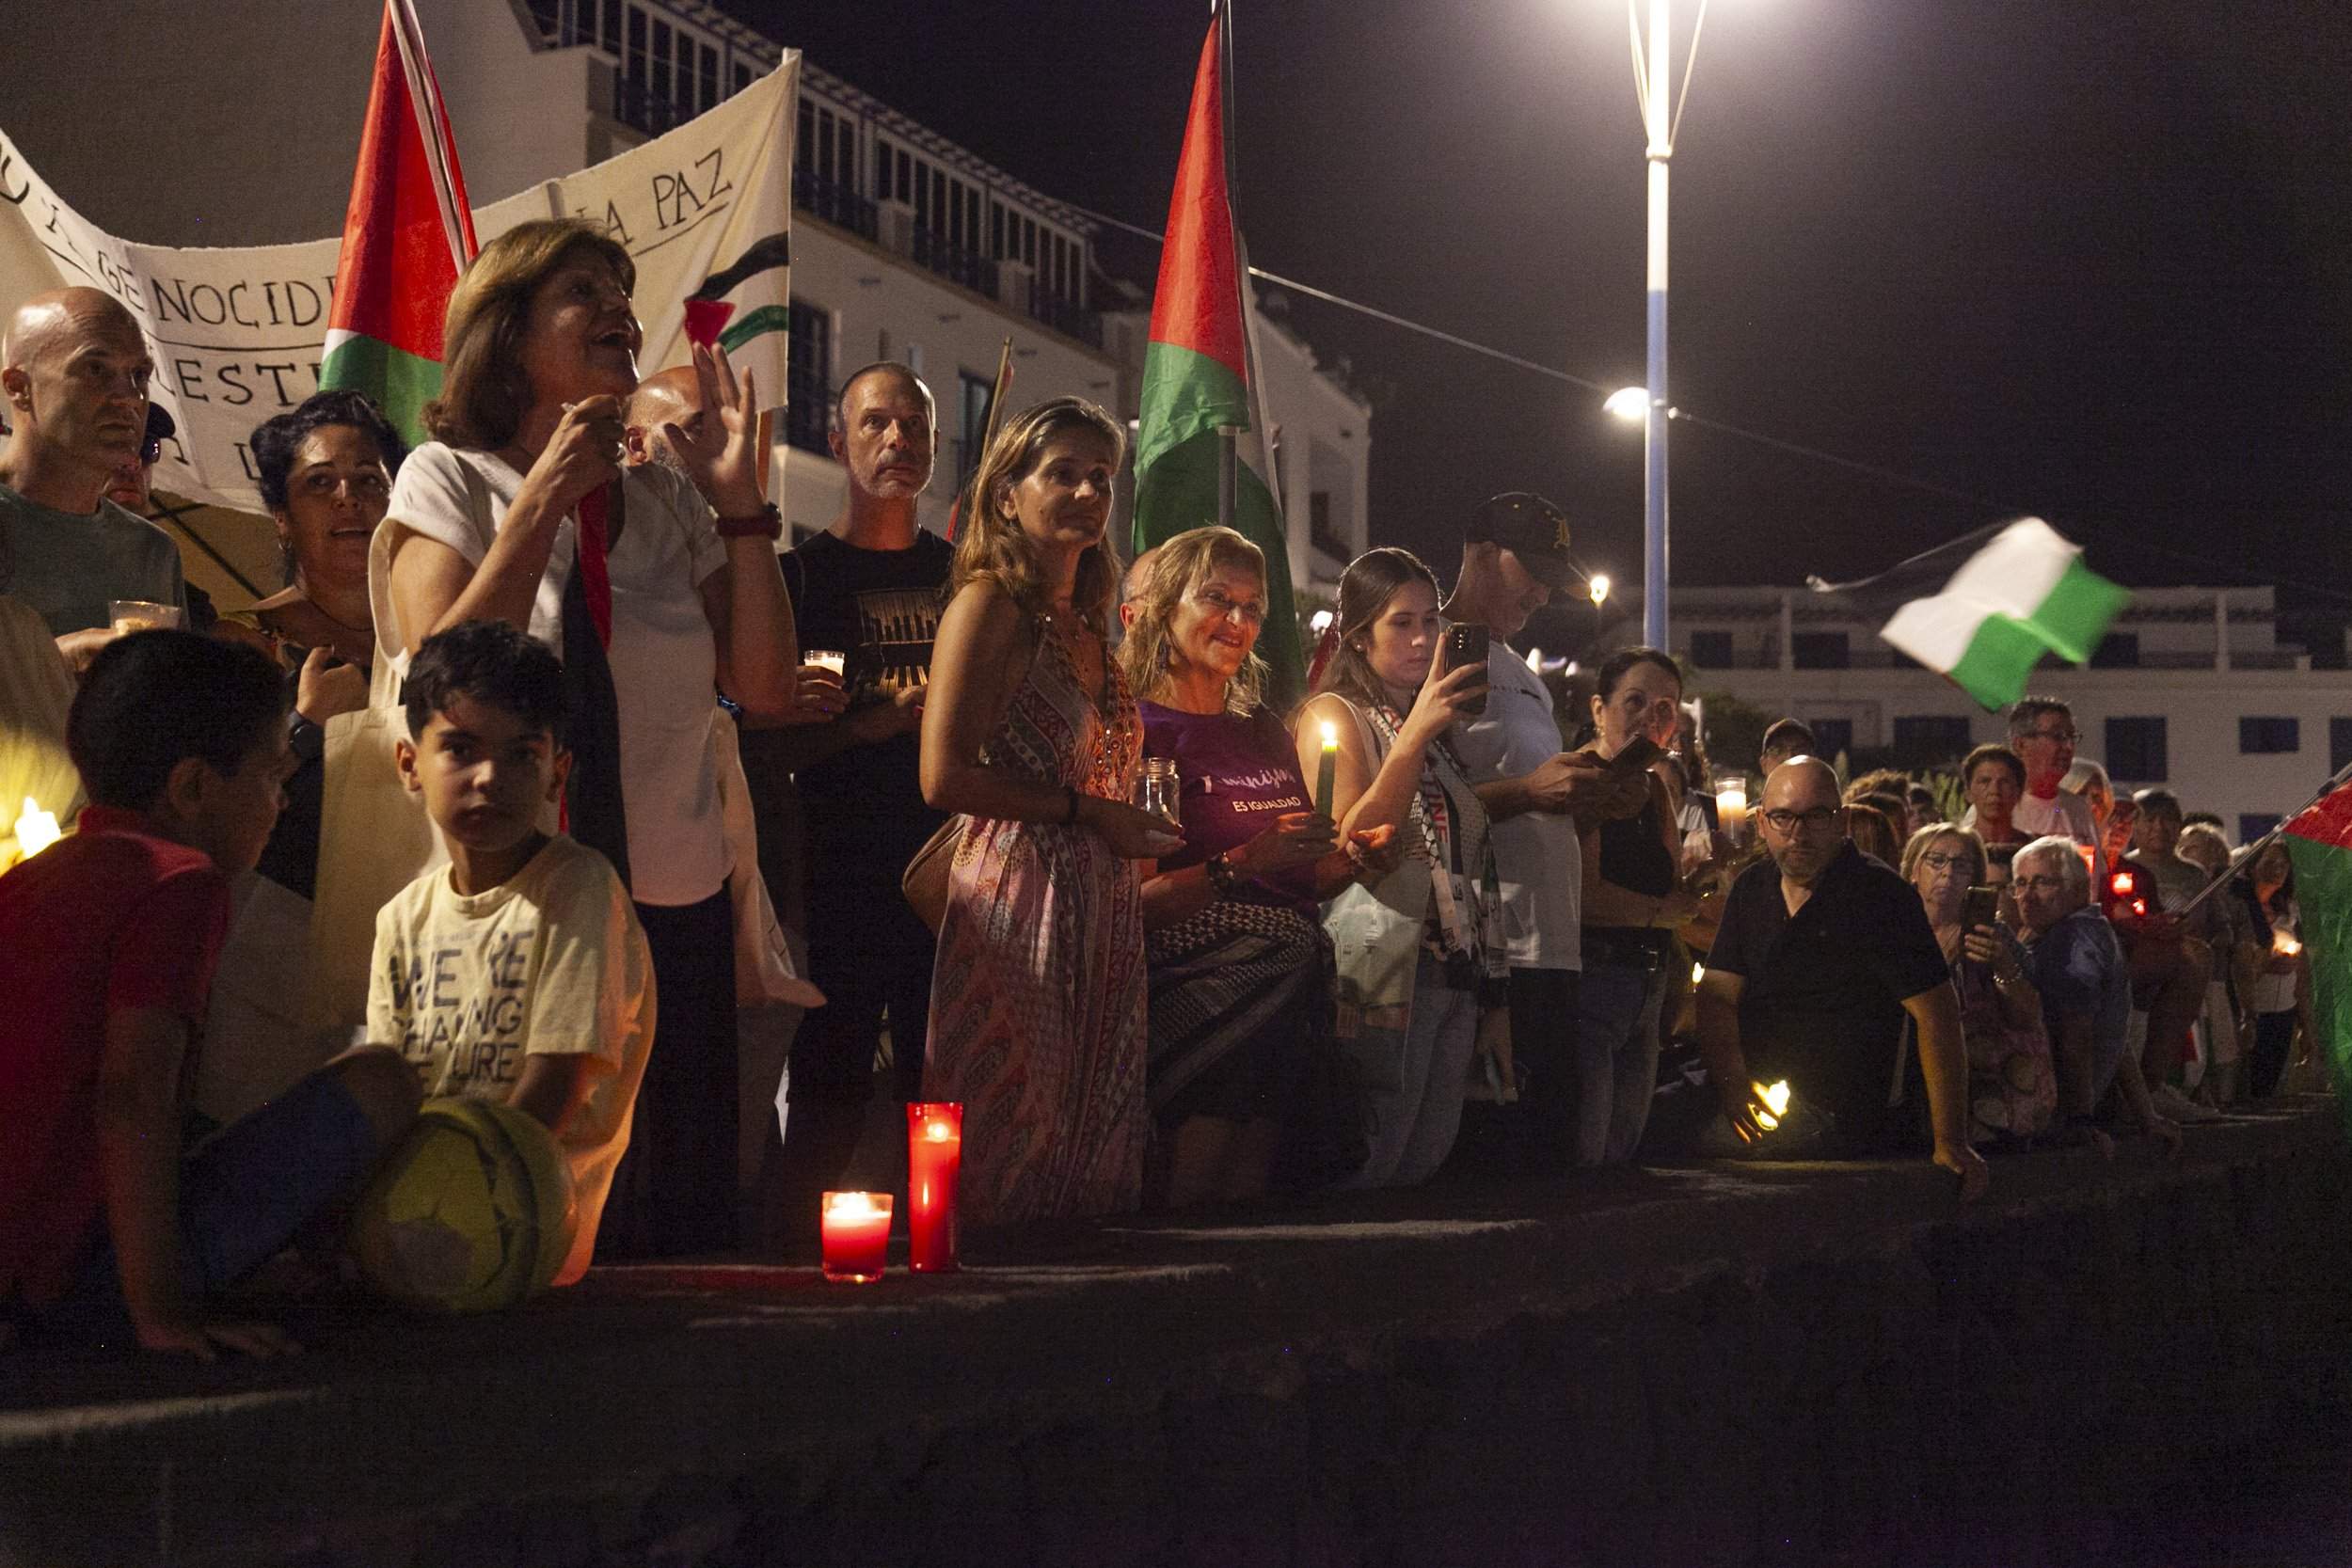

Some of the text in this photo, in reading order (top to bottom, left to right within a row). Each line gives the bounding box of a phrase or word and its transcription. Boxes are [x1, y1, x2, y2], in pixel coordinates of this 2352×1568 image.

[575, 148, 732, 245] A PAZ
[1232, 797, 1301, 812] ES IGUALDAD
[389, 949, 462, 1012] WE
